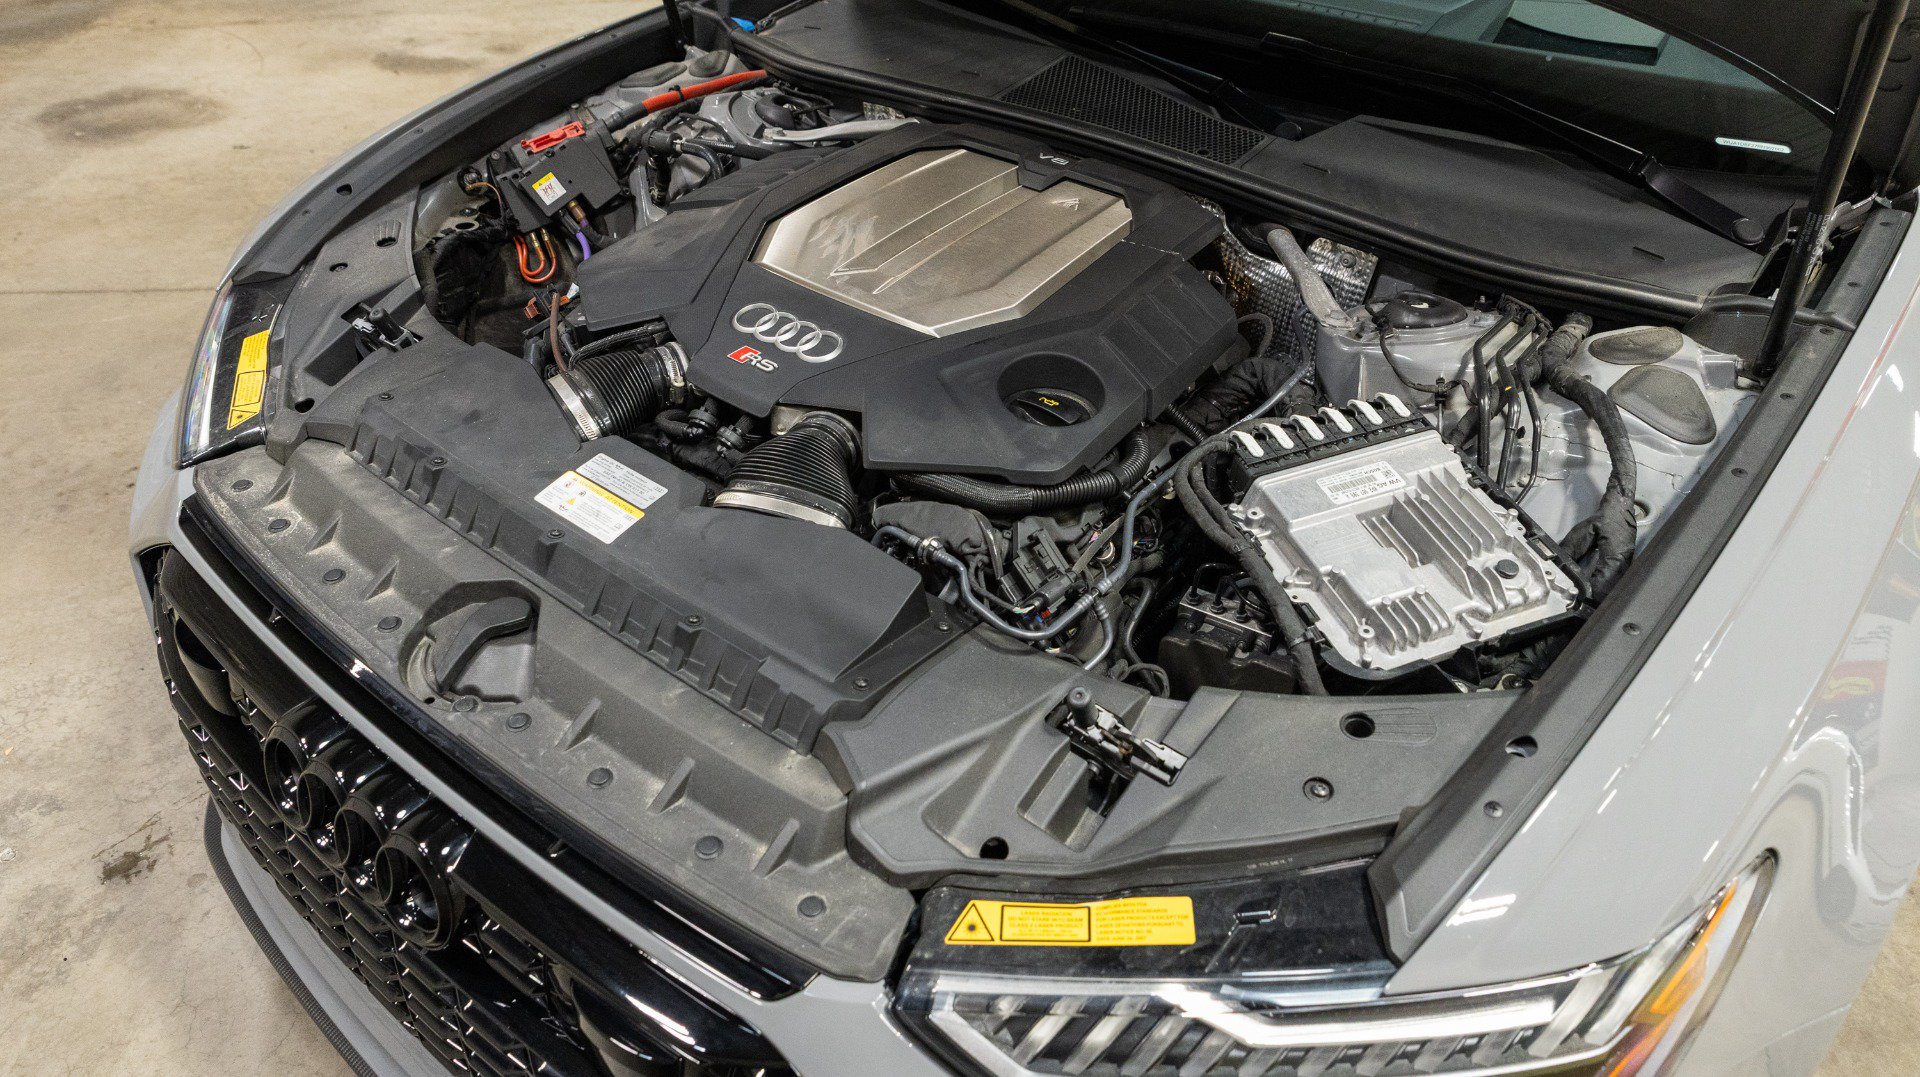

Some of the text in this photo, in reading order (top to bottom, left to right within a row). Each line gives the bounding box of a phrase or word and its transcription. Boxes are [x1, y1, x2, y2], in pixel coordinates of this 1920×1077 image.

[1040, 152, 1069, 165] V8
[739, 351, 779, 372] RS
[604, 495, 634, 513] ATTENTION
